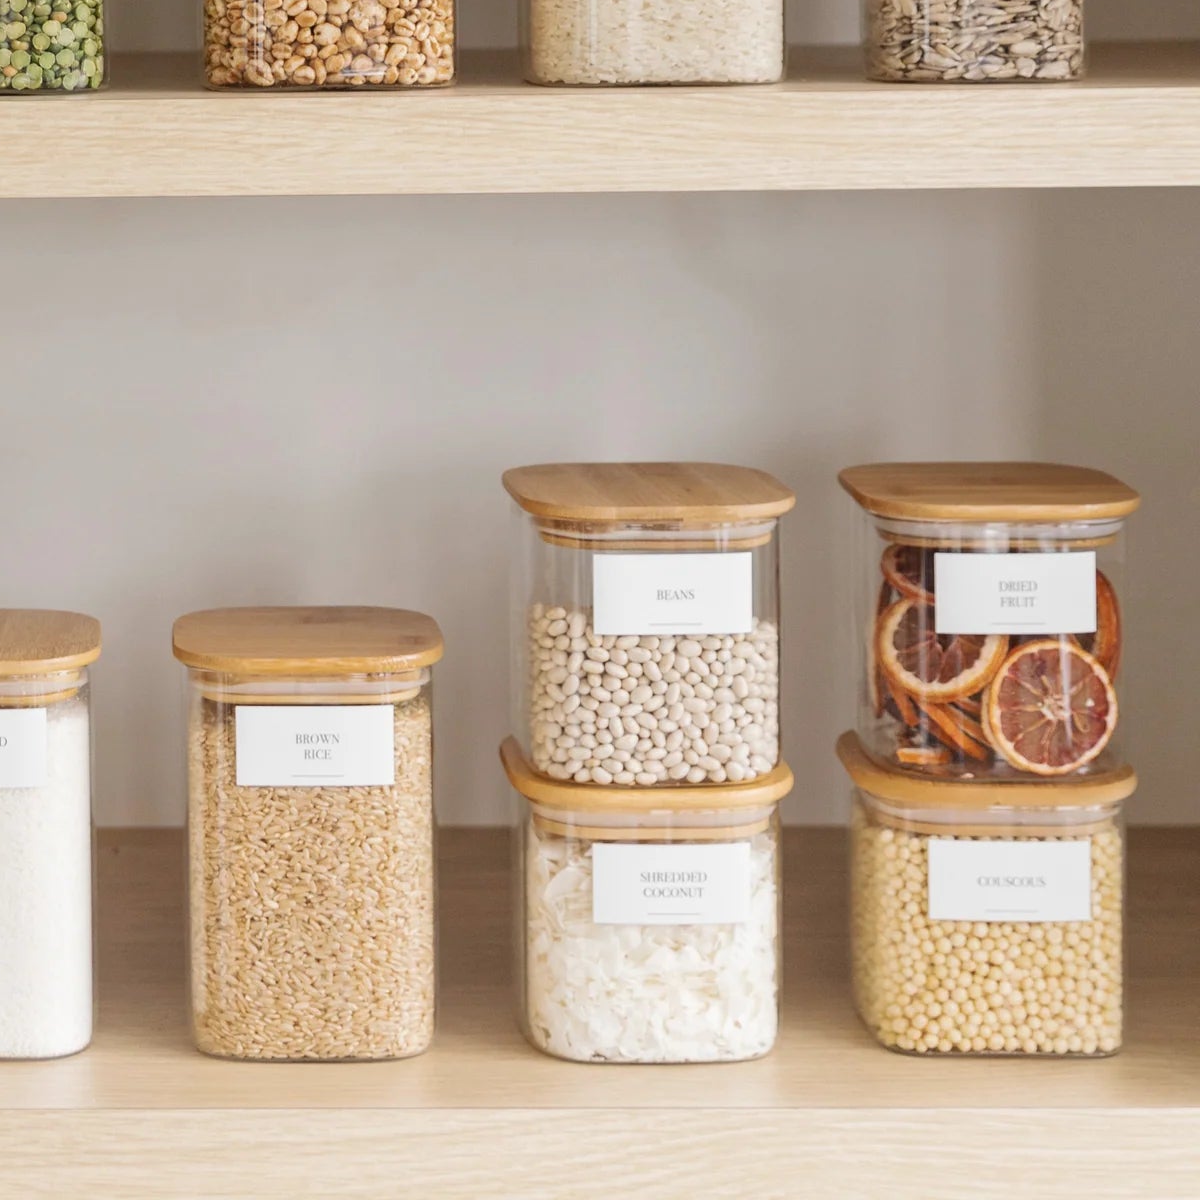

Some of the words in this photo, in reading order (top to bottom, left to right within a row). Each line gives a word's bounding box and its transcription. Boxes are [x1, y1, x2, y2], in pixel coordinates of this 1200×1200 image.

[997, 581, 1039, 593] DRIED
[656, 590, 696, 601] BEANS
[999, 596, 1037, 609] FRUIT
[294, 734, 341, 746] BROWN
[303, 749, 332, 761] RICE
[639, 872, 708, 884] SHREDDED
[975, 876, 1047, 888] COUSCOUS
[642, 887, 705, 899] COCONUT
